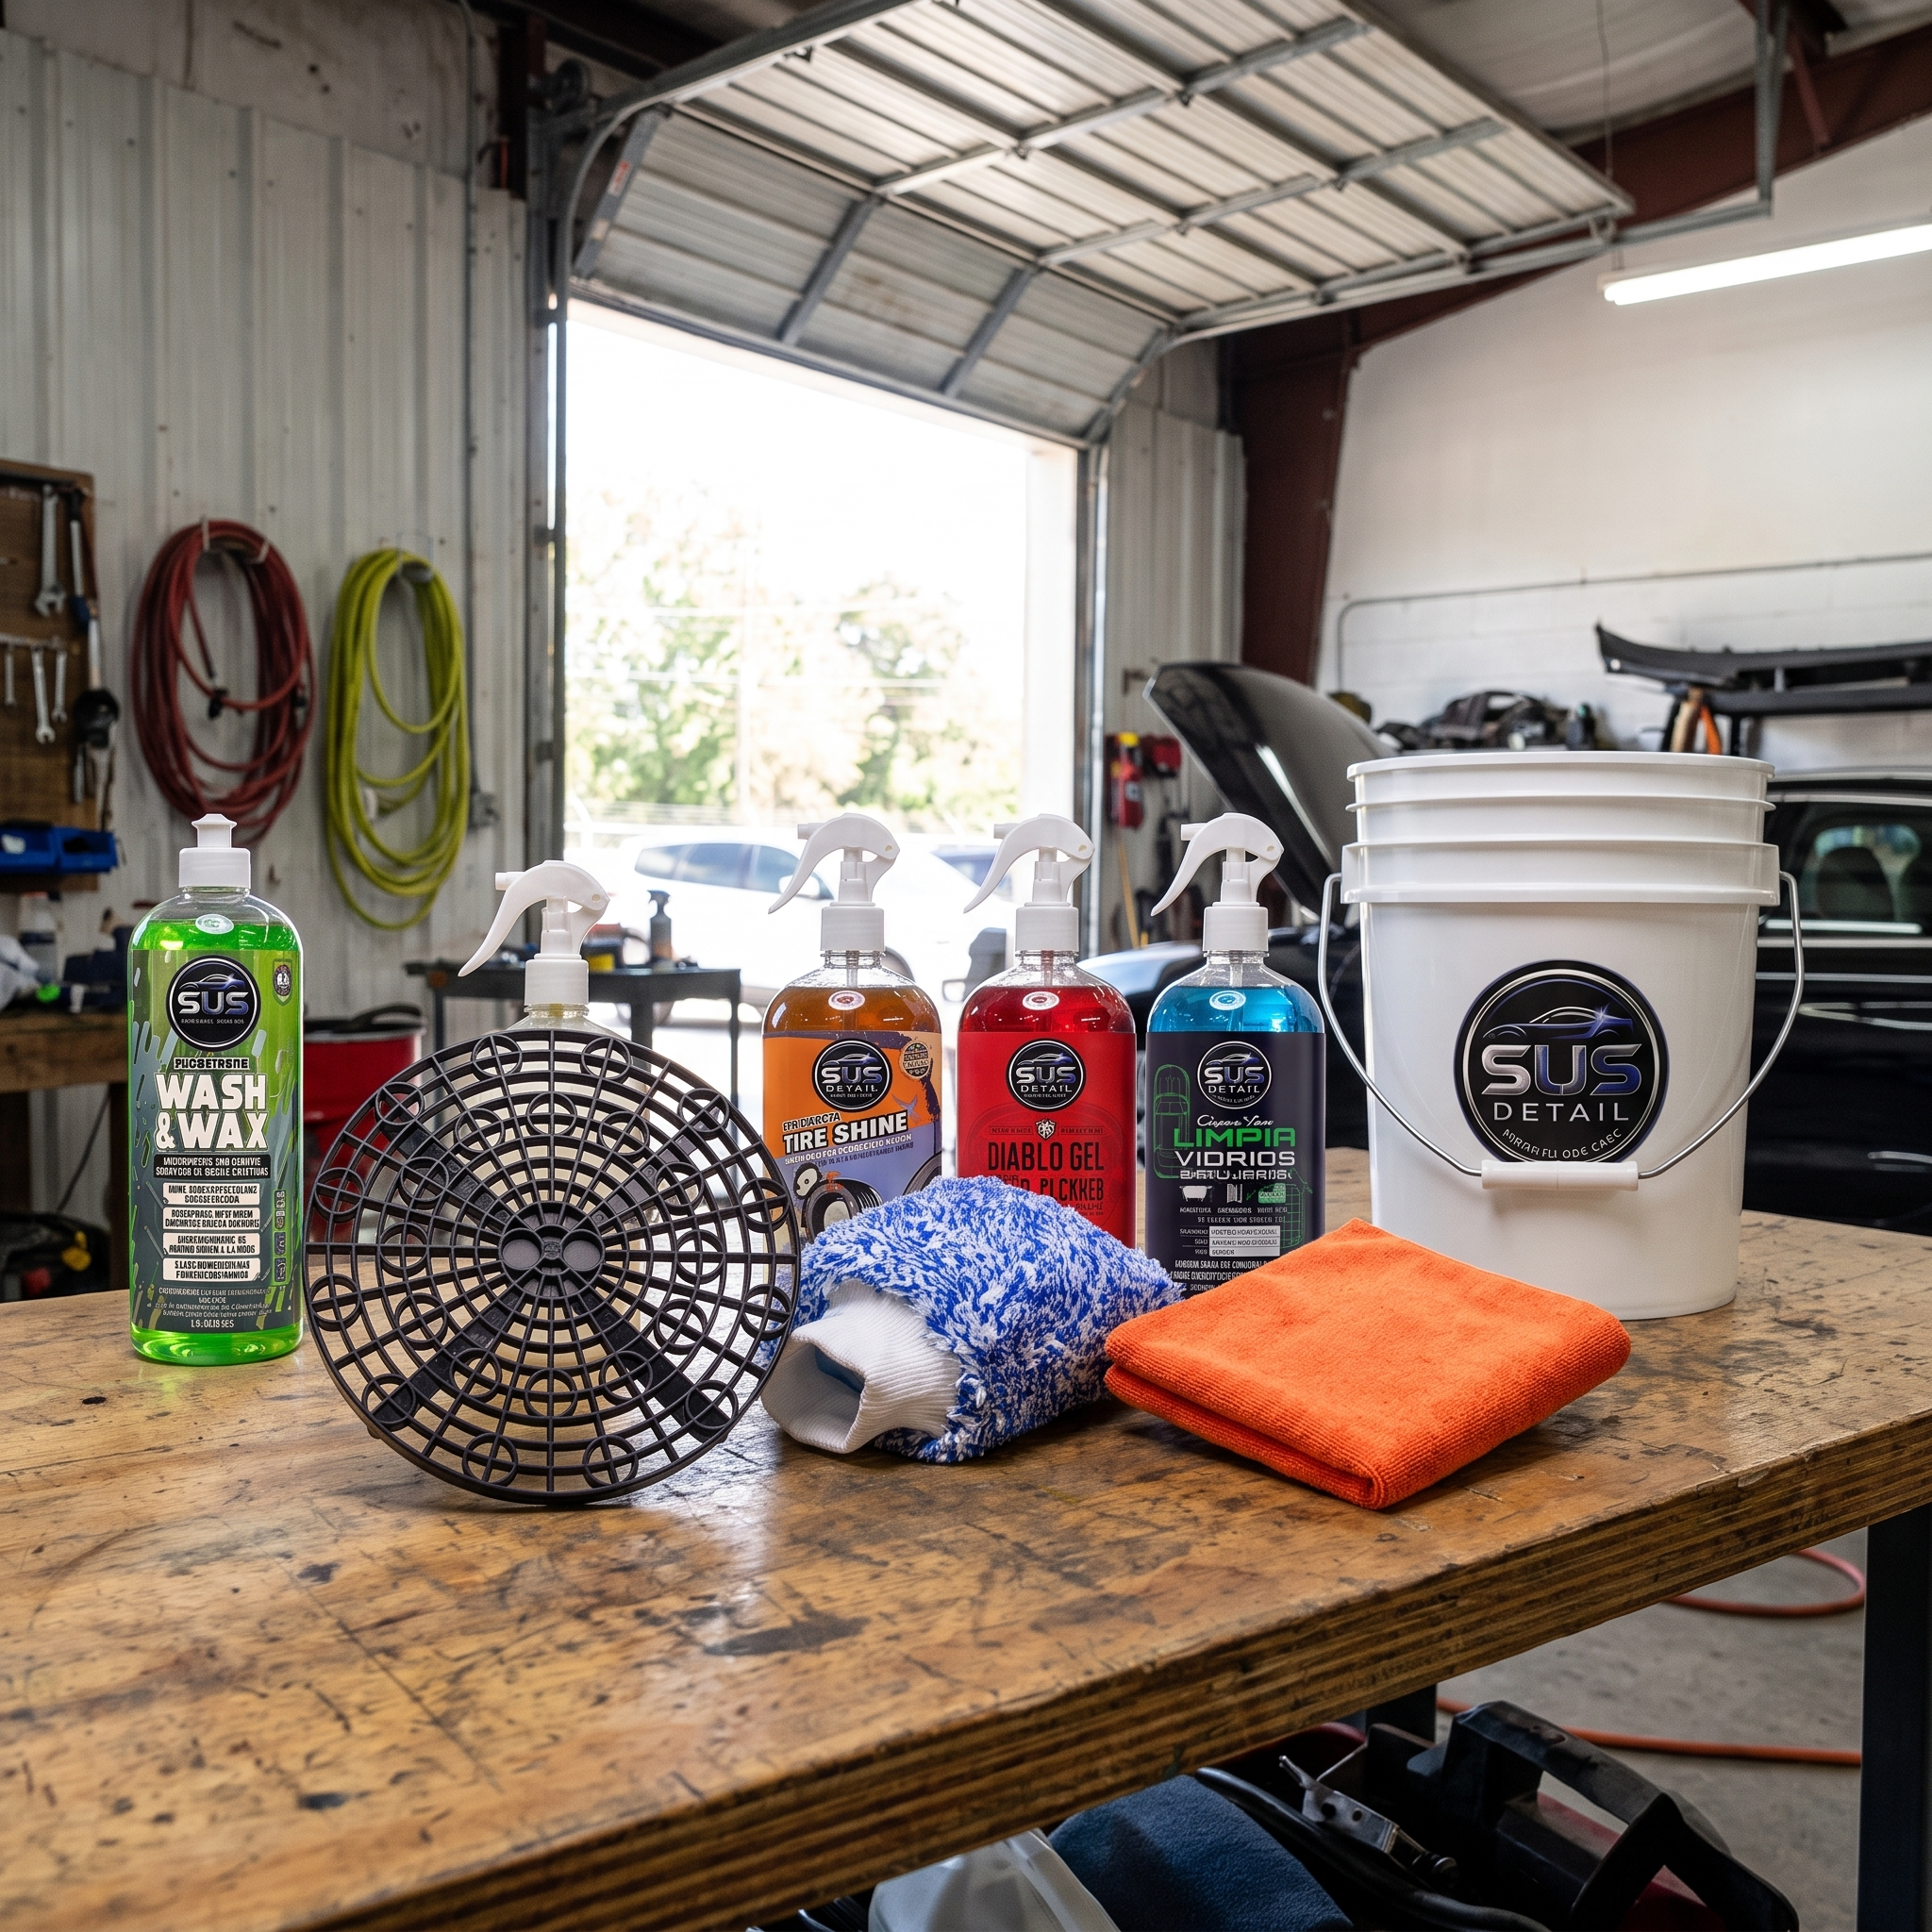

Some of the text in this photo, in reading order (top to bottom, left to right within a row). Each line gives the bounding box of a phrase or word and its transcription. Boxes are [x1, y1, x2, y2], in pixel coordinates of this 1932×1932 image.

[177, 991, 249, 1015] SUS
[822, 1067, 883, 1084] SUS
[1016, 1067, 1076, 1084] SUS
[1204, 1066, 1265, 1084] SUS
[1481, 1043, 1642, 1097] SUS
[156, 1074, 266, 1109] WASH
[1021, 1084, 1073, 1092] DETAIL
[1208, 1085, 1260, 1093] DETAIL
[1493, 1102, 1630, 1123] DETAIL
[156, 1112, 268, 1149] & WAX
[783, 1111, 908, 1154] TIRE SHINE
[1174, 1127, 1296, 1147] LIMPIA
[988, 1141, 1105, 1171] DIABLO GEL
[1174, 1151, 1296, 1167] VIDRIOS
